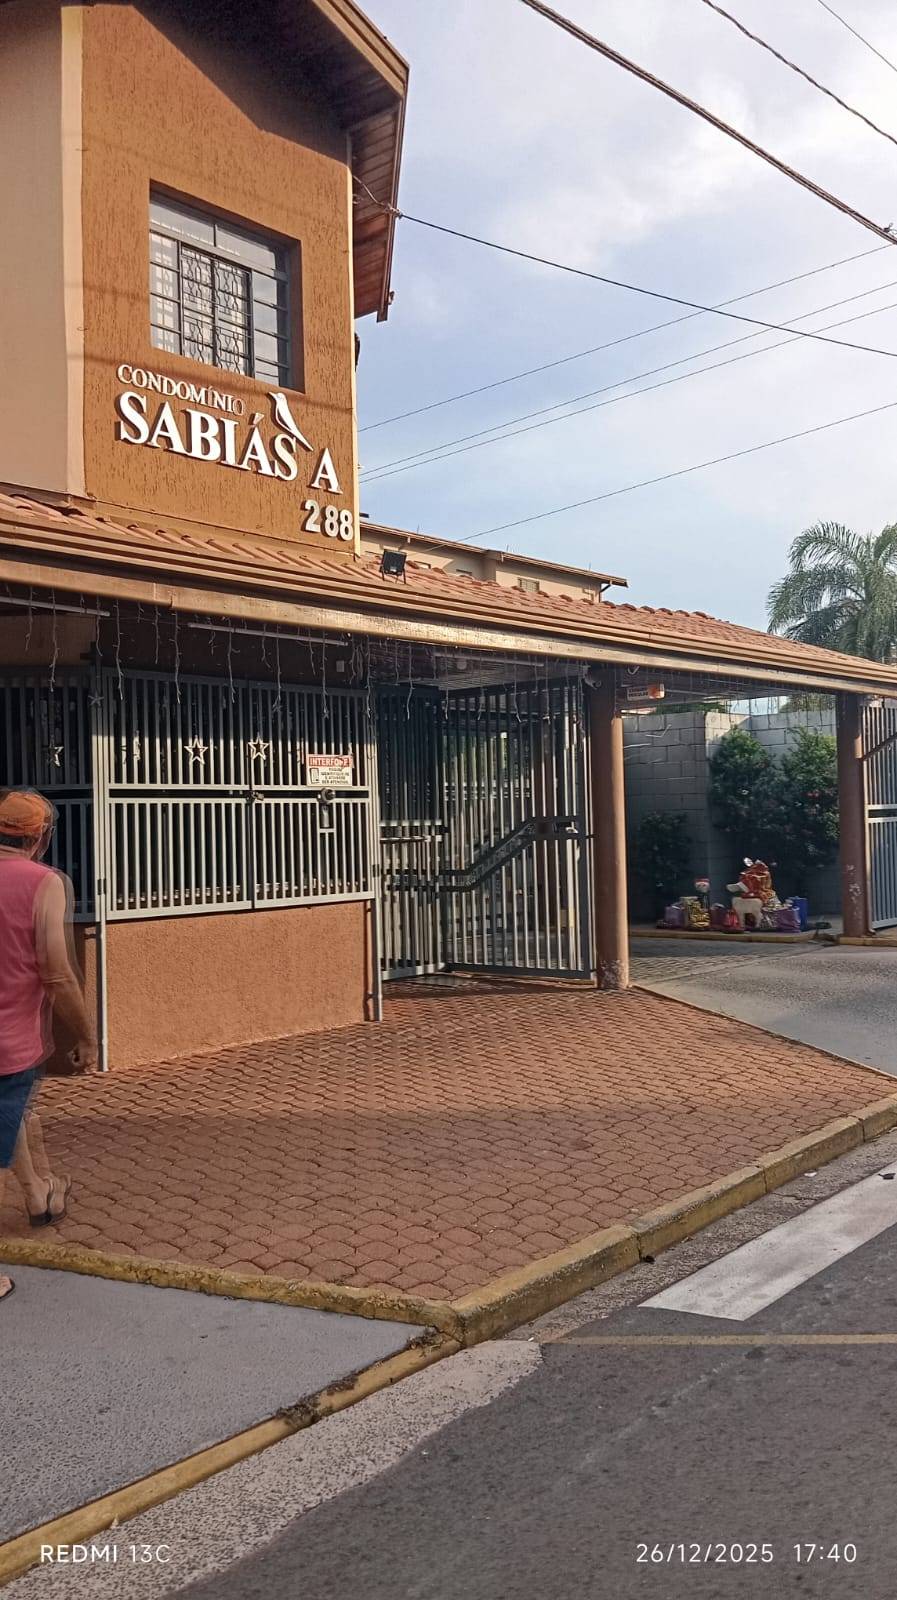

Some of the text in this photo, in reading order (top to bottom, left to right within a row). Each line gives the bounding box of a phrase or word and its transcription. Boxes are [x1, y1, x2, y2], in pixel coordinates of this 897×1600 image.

[117, 364, 245, 416] CONDOMÍNIO
[118, 391, 343, 495] SABIÁS A
[304, 499, 354, 541] 288
